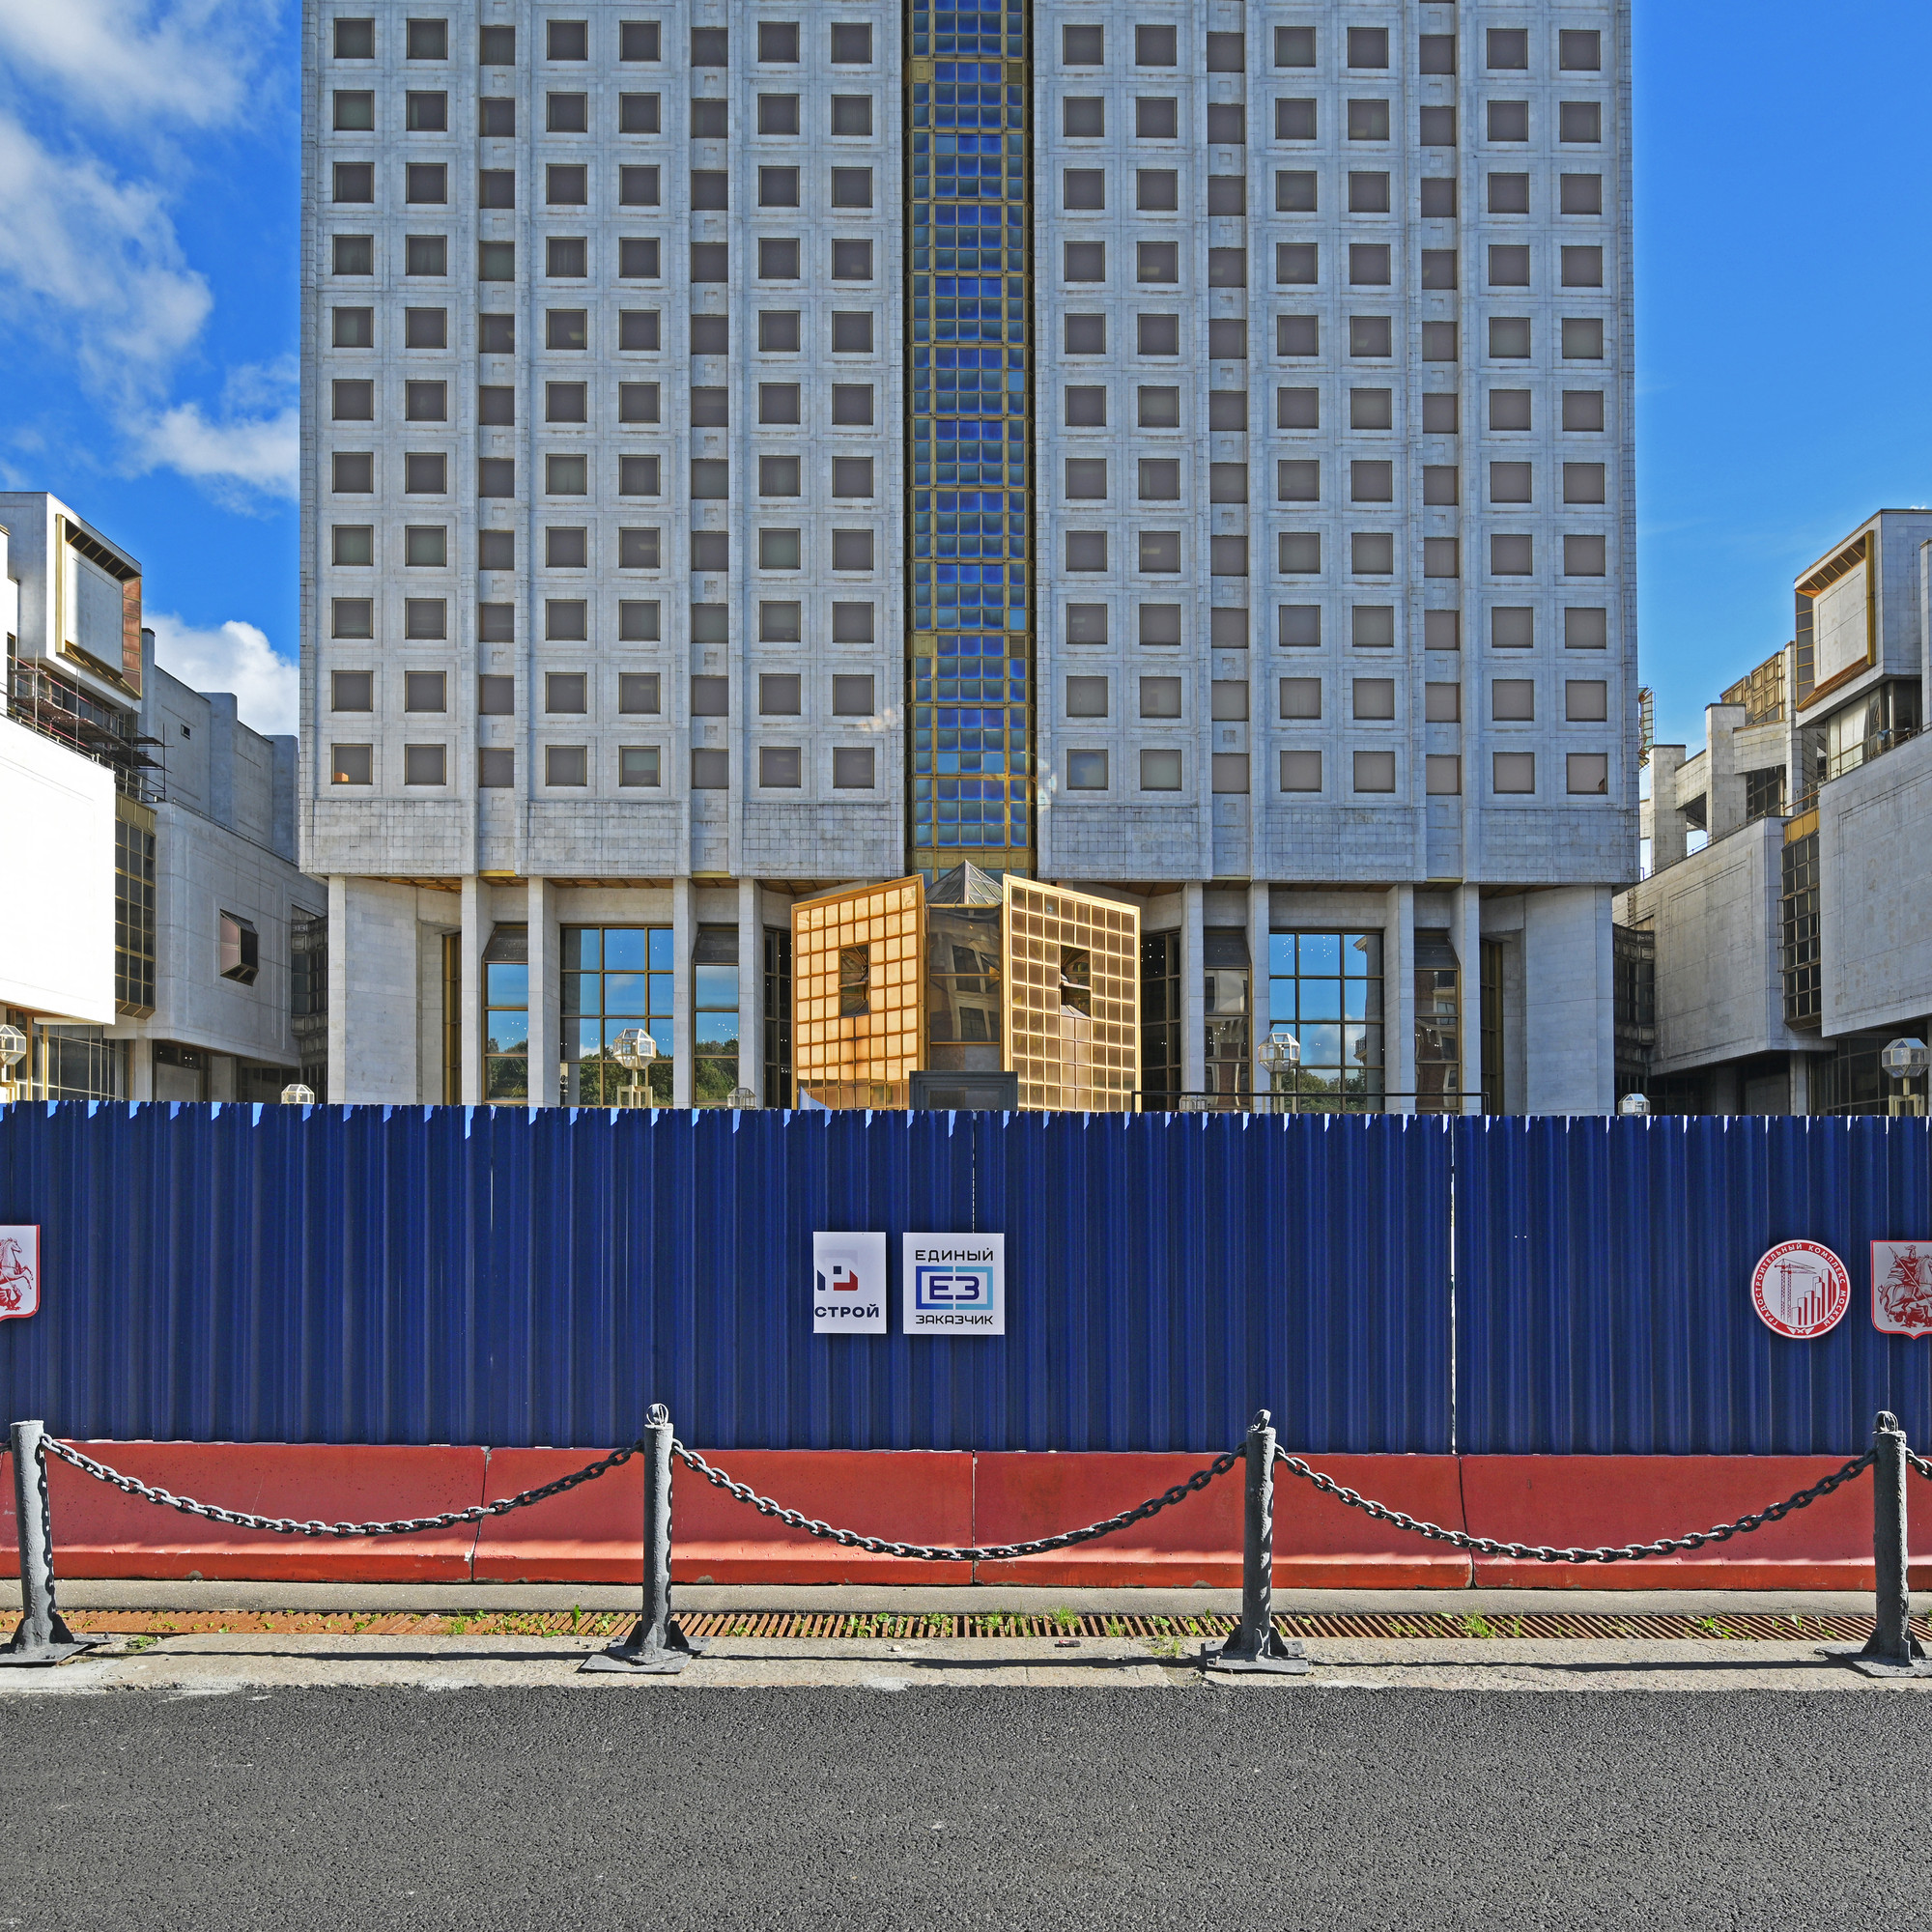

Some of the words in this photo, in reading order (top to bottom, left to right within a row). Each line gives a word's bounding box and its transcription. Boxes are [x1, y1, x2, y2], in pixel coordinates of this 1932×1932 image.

[915, 1247, 994, 1263] ЕДИНЫЙ
[1807, 1244, 1846, 1284] КОМПЛЕКС
[1755, 1242, 1803, 1326] ГРАДОСТРОИТЕЛЬНЫЙ
[814, 1303, 879, 1318] СТРОЙ
[915, 1315, 994, 1325] ЗАКАЗЧИК
[1823, 1290, 1847, 1326] МОСКВЫ
